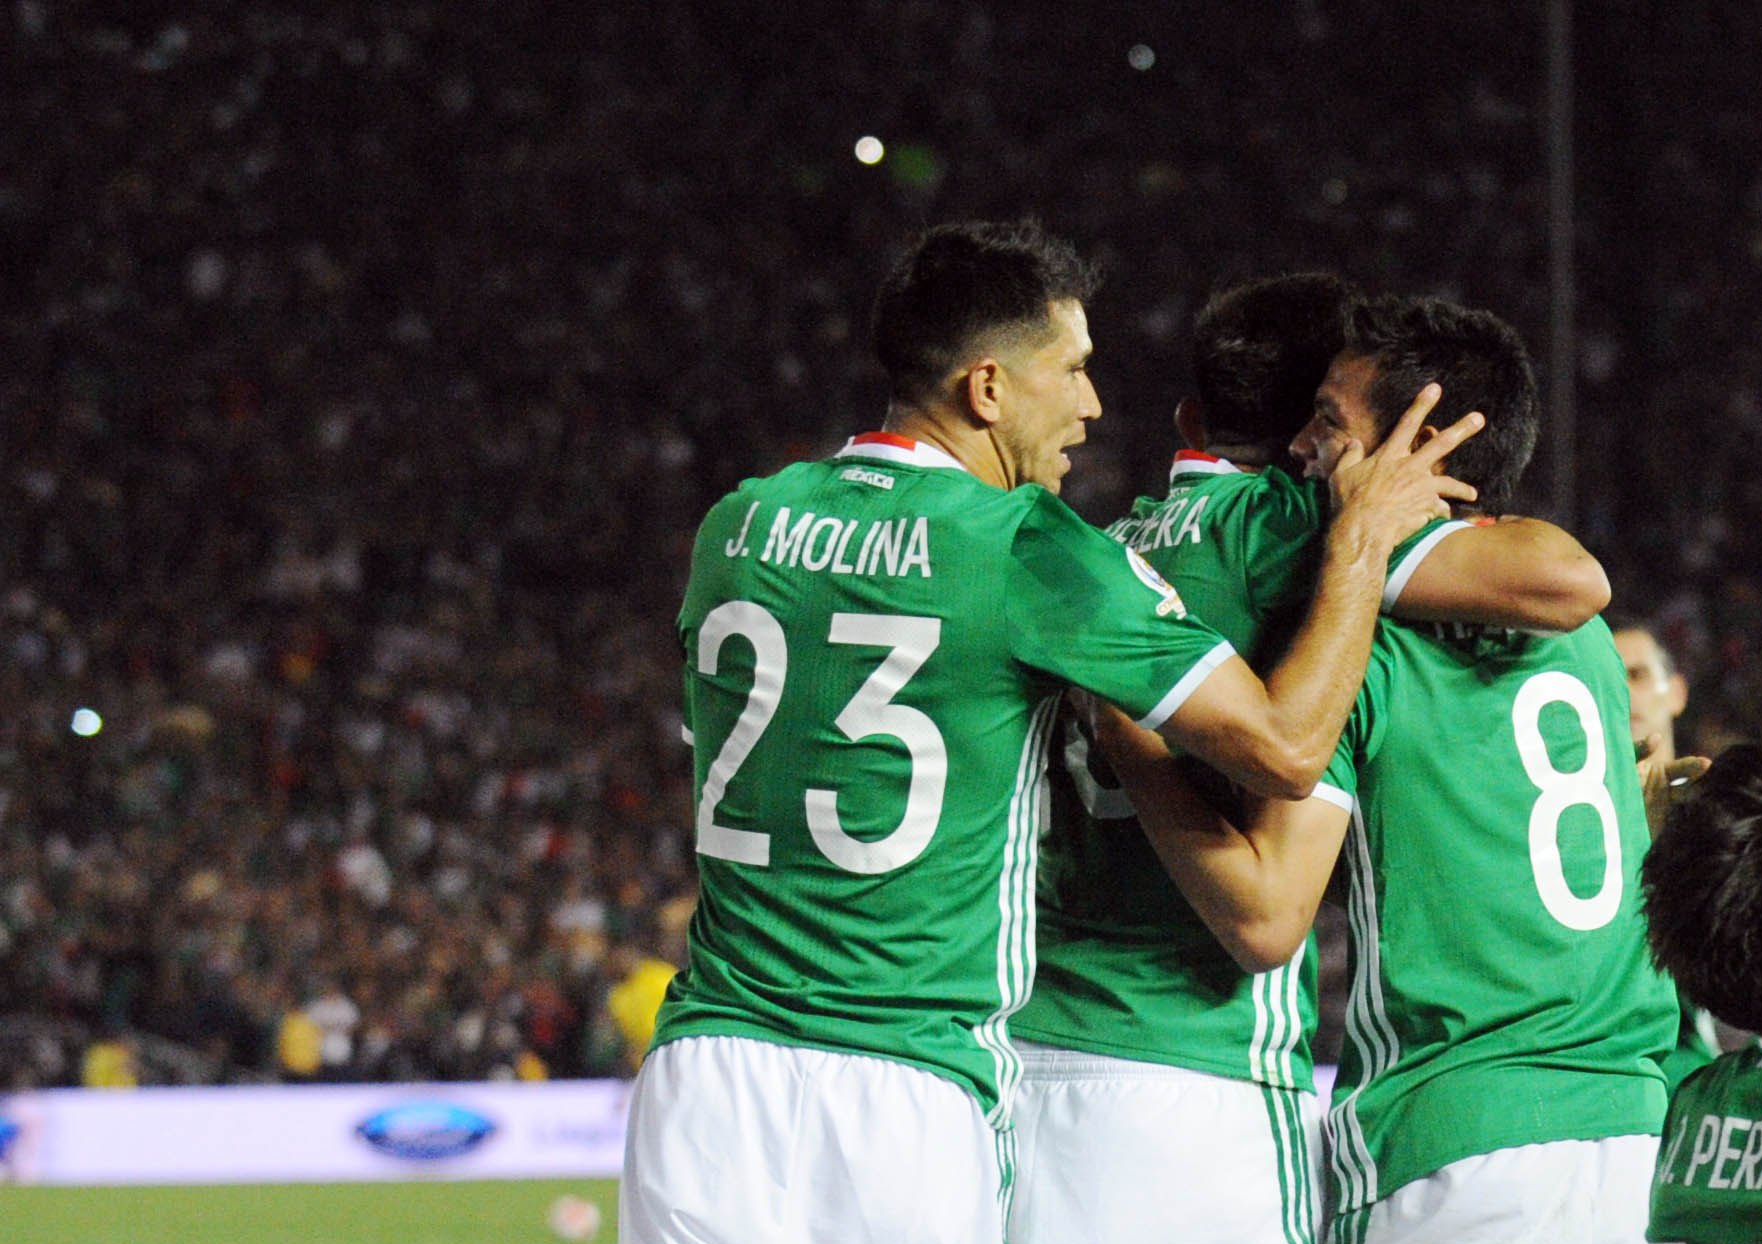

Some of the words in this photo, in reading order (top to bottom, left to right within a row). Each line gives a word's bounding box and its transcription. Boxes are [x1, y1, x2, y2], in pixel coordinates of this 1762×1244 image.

[725, 500, 760, 558] J.
[760, 505, 932, 578] MOLINA
[695, 600, 948, 875] 23
[1511, 670, 1624, 932] 8
